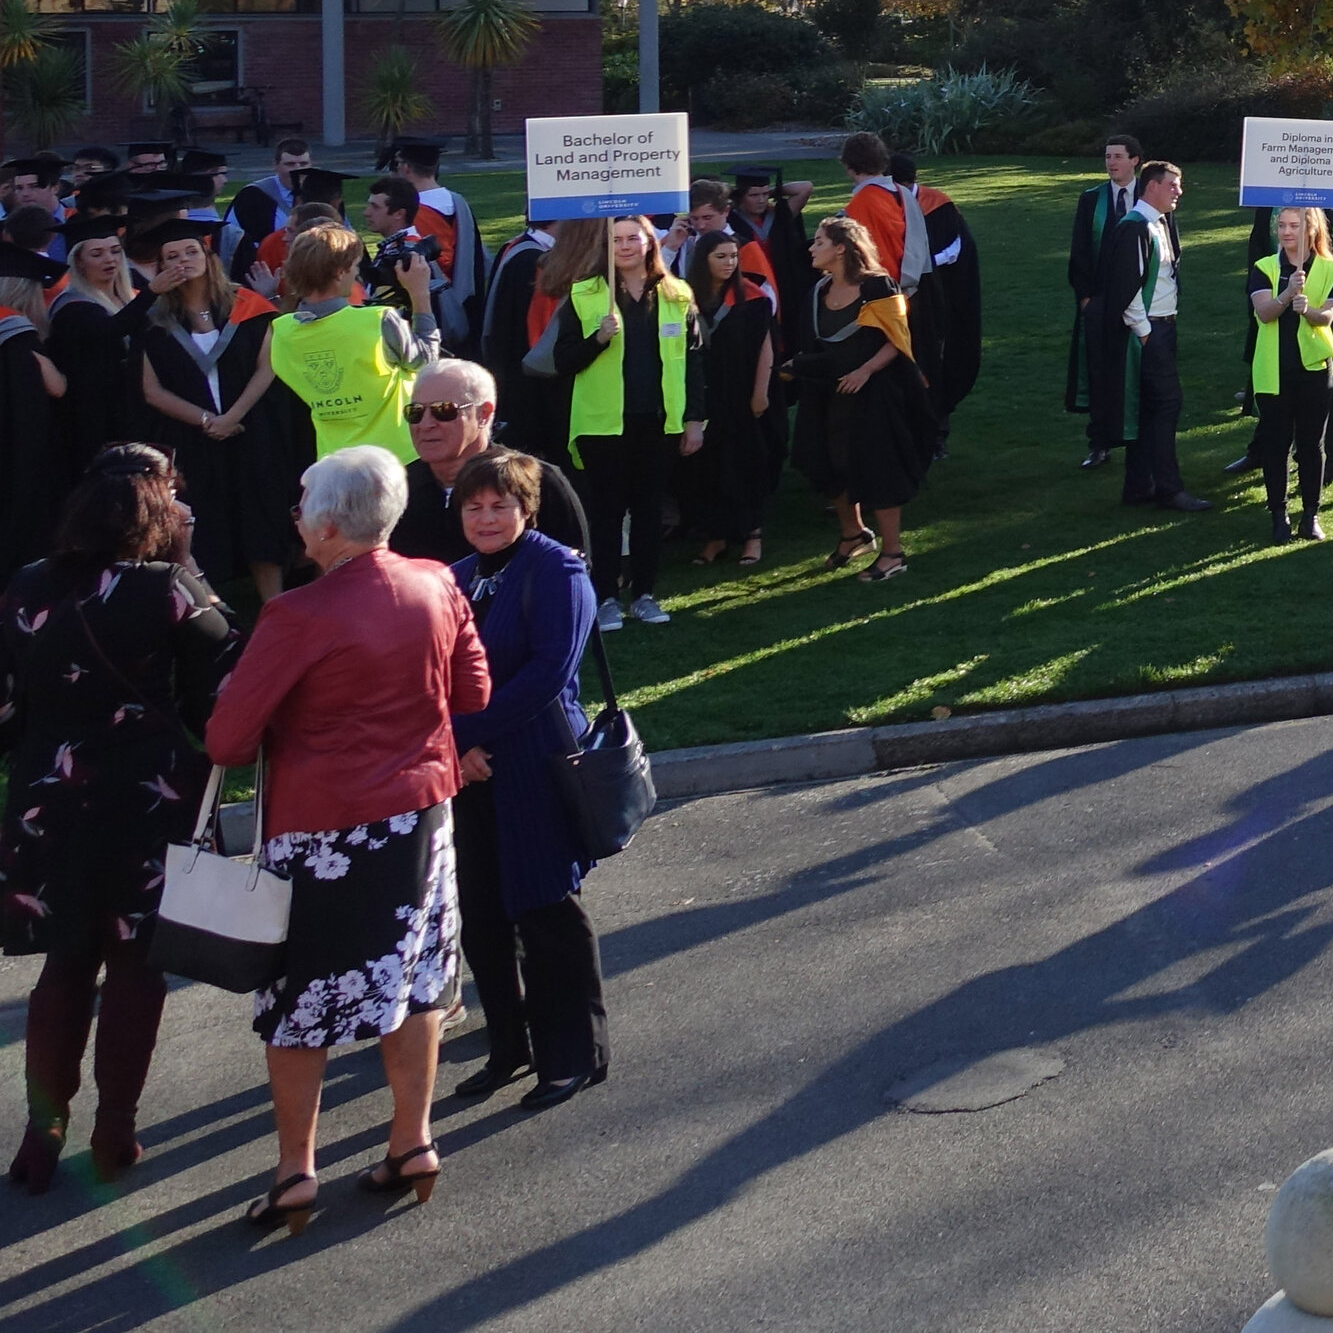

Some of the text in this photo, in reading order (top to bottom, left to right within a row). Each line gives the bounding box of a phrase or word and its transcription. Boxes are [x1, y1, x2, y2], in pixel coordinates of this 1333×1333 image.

[563, 131, 654, 147] Bachelor of
[1282, 132, 1333, 143] Diploma in
[1261, 143, 1286, 152] Farm
[535, 149, 681, 165] Land and Property
[1270, 155, 1289, 164] and
[1291, 155, 1331, 165] Diploma
[556, 166, 662, 182] Management
[1278, 166, 1333, 177] Agriculture
[310, 395, 363, 409] INCOLN
